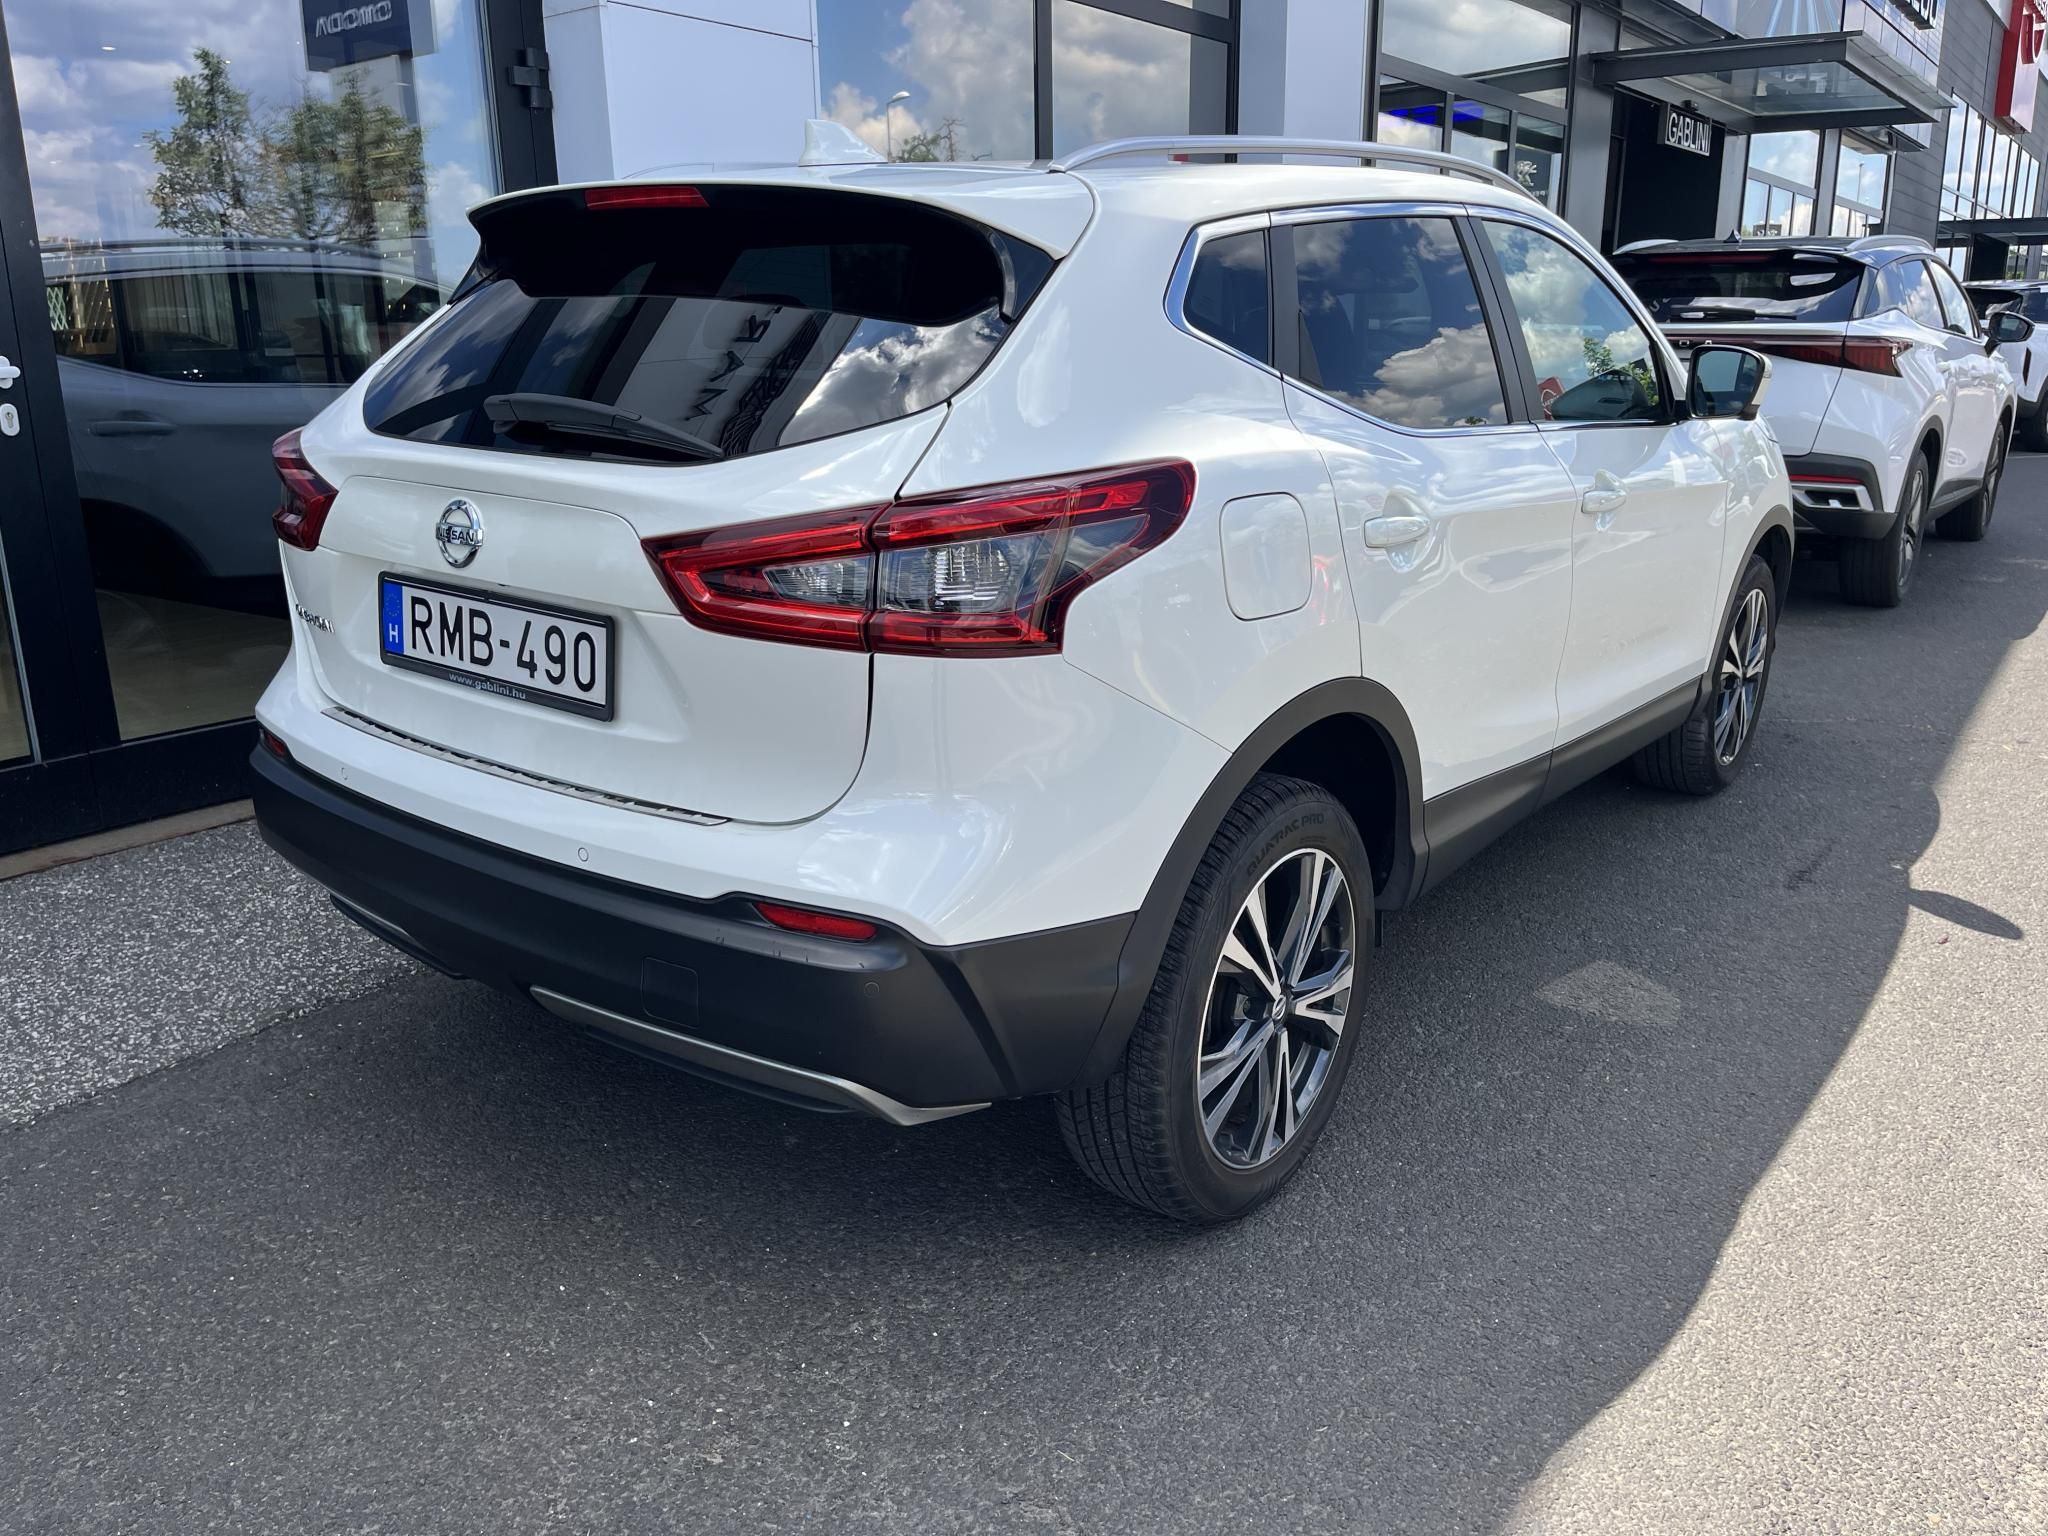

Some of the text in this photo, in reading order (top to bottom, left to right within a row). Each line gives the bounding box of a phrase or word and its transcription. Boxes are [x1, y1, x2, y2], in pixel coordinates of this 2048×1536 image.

[1669, 112, 1710, 154] GABLINI
[388, 622, 399, 644] H
[411, 595, 597, 693] RMB-490
[448, 673, 527, 700] www.gablini.hu
[1247, 812, 1325, 877] QUATRAC PRO
